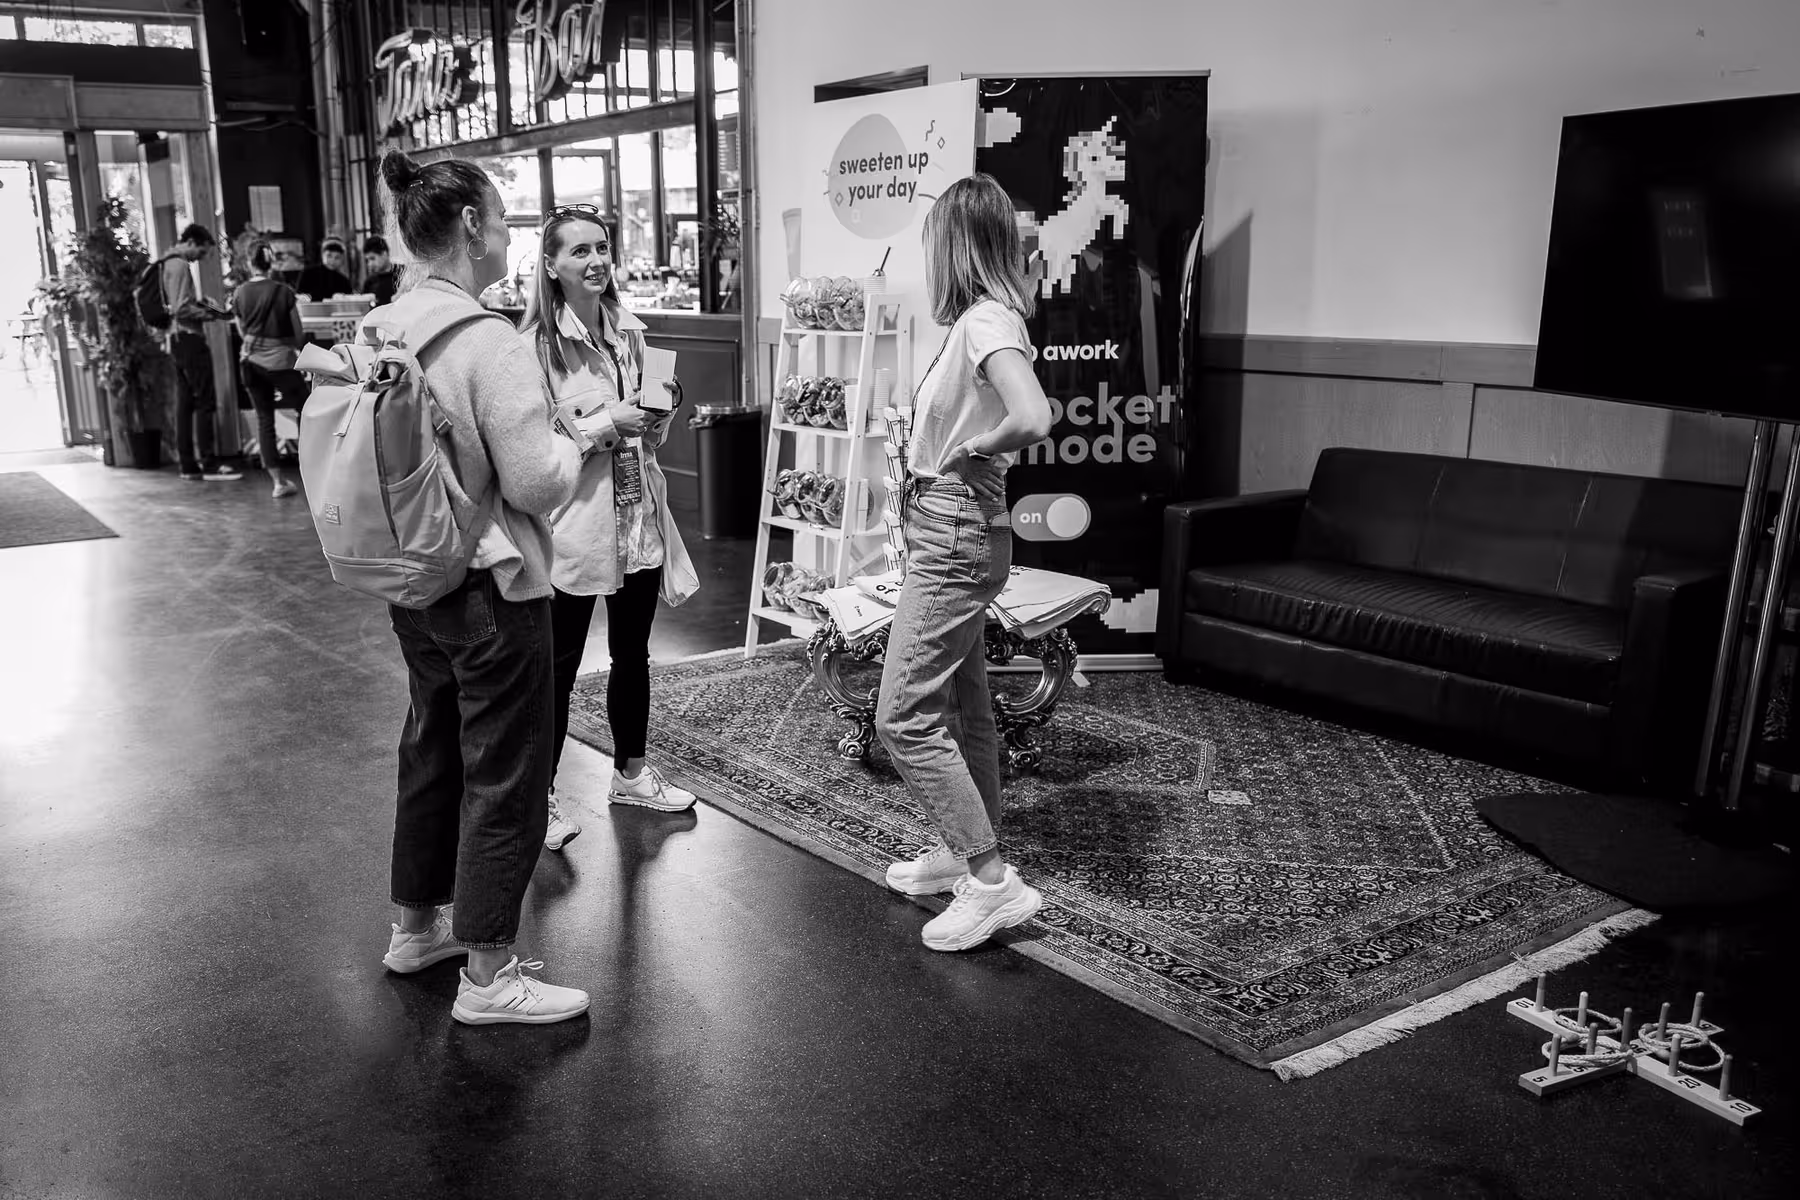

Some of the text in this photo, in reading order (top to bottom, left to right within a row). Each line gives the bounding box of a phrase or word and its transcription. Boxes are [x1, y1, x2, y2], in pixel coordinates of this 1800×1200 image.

[839, 152, 929, 175] sweeten up
[848, 175, 918, 207] your day
[1042, 339, 1120, 361] awork
[1019, 512, 1042, 524] on
[1677, 1077, 1702, 1090] 20
[1729, 1102, 1753, 1114] 10
